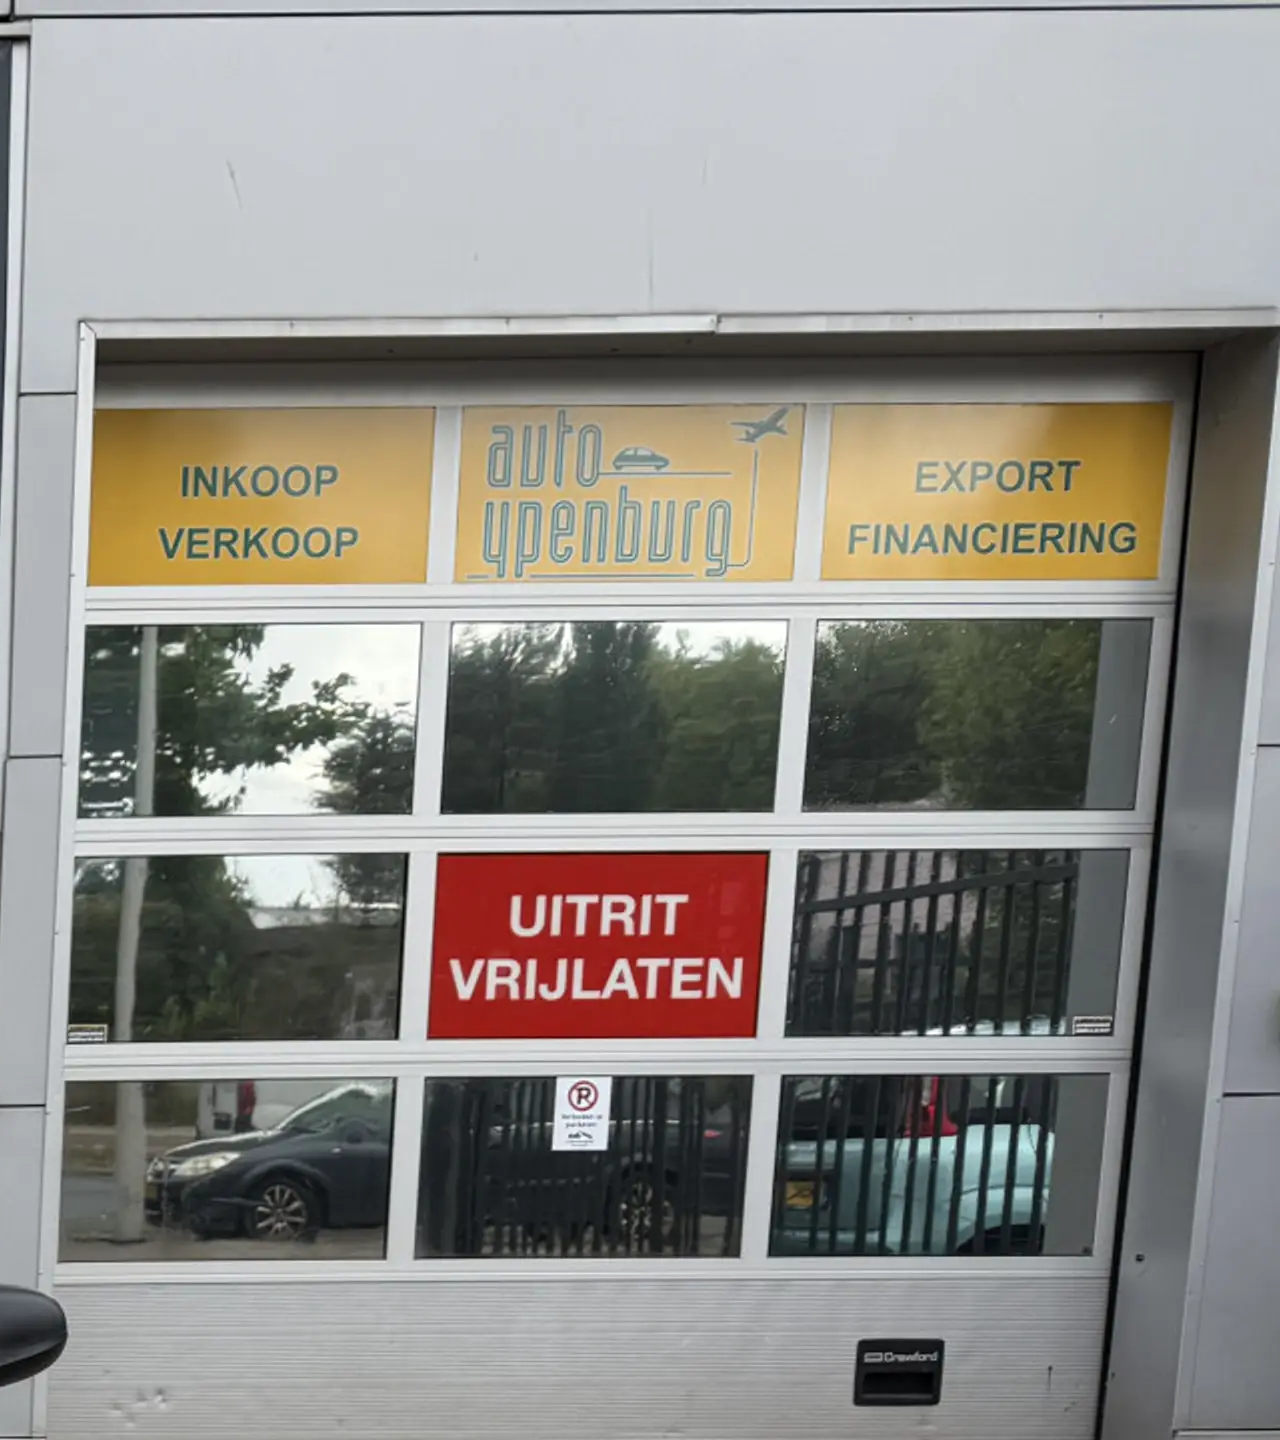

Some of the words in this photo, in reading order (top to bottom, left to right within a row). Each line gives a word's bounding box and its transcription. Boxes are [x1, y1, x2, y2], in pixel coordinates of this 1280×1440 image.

[486, 409, 603, 490] auto
[179, 463, 340, 501] INKOOP
[913, 459, 1082, 495] EXPORT
[158, 526, 361, 561] VERKOOP
[481, 482, 733, 578] ypenburg
[846, 520, 1140, 557] FINANCIERING
[508, 893, 690, 938] UITRIT
[448, 956, 744, 1001] VRIJLATEN
